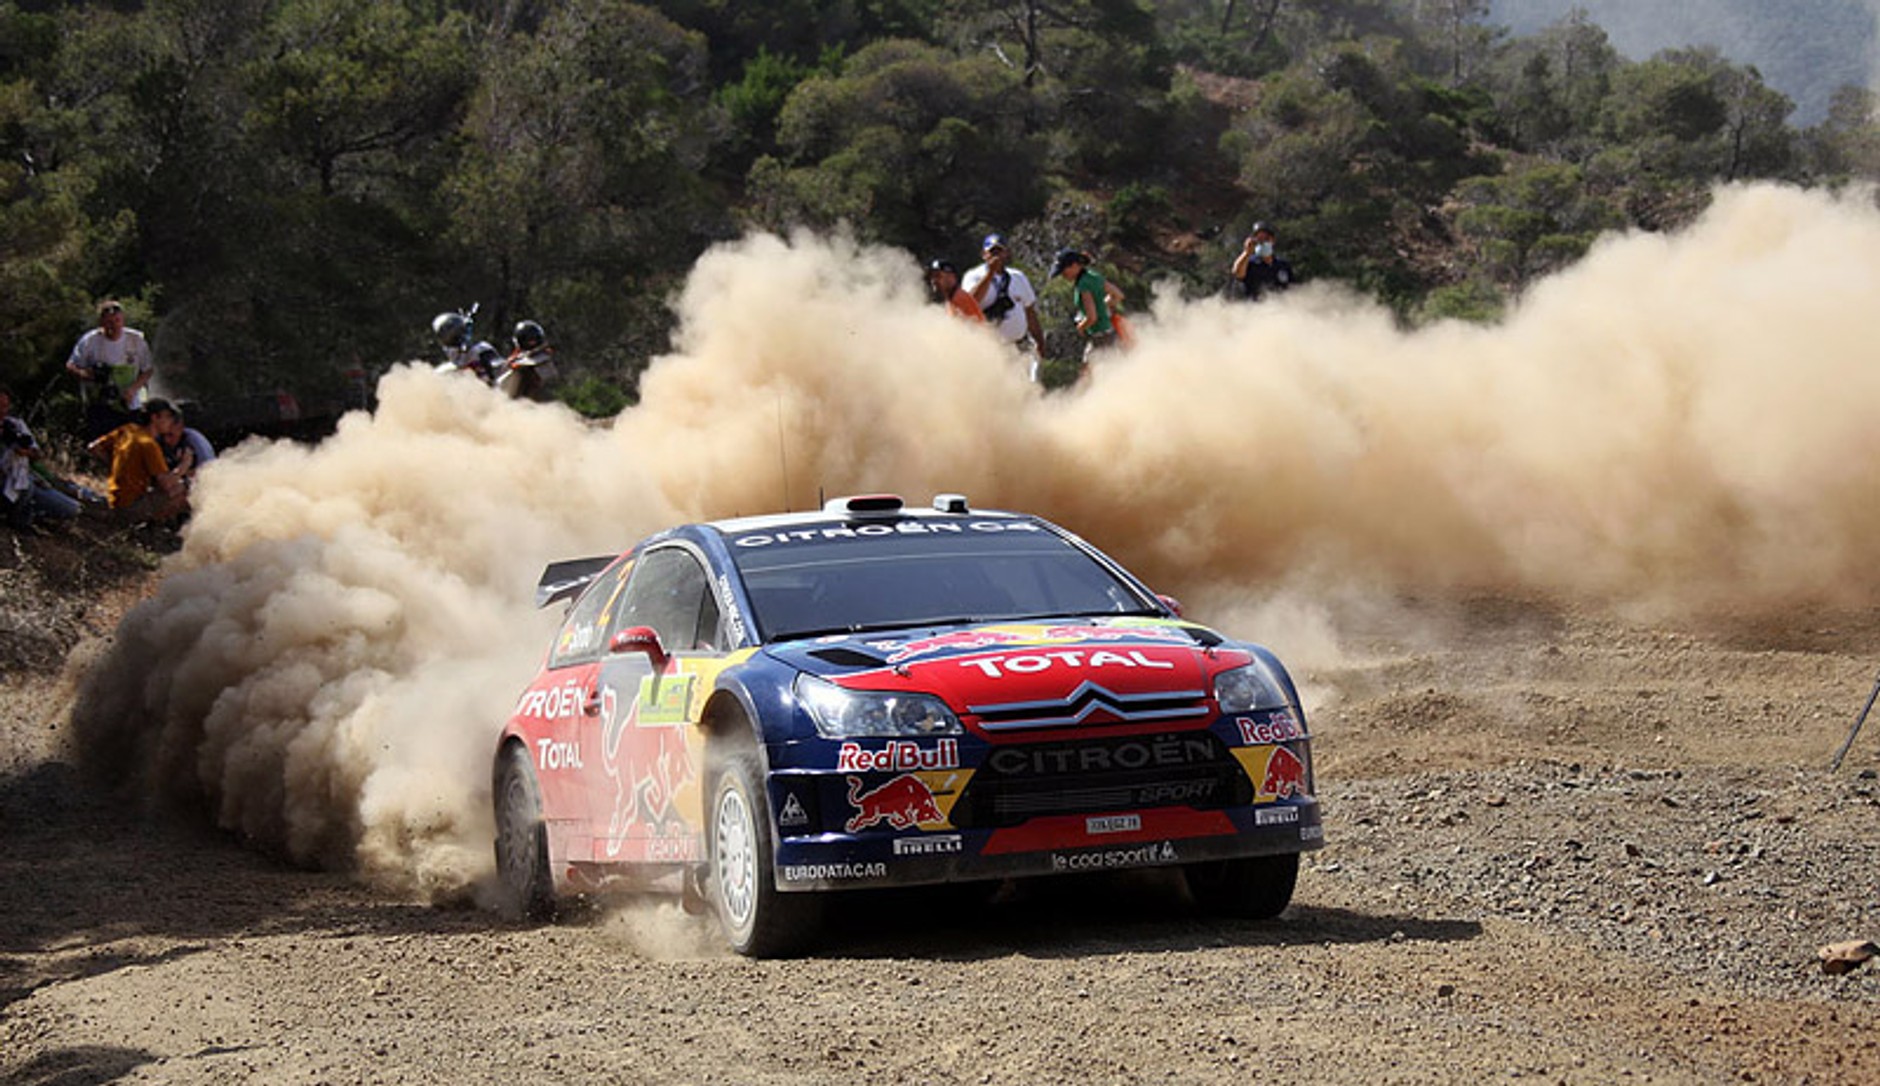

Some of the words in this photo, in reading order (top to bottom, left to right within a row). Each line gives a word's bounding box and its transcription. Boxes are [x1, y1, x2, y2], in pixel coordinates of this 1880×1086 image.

[736, 519, 963, 547] CITROËN
[968, 521, 1040, 532] C4
[959, 650, 1174, 677] TOTAL
[517, 679, 589, 720] TROËN
[537, 737, 584, 771] TOTAL
[837, 740, 896, 771] Red
[897, 738, 960, 770] Bull
[988, 734, 1215, 774] CITROËN
[893, 834, 962, 855] PIRELLI
[784, 862, 887, 881] EURODATACAR
